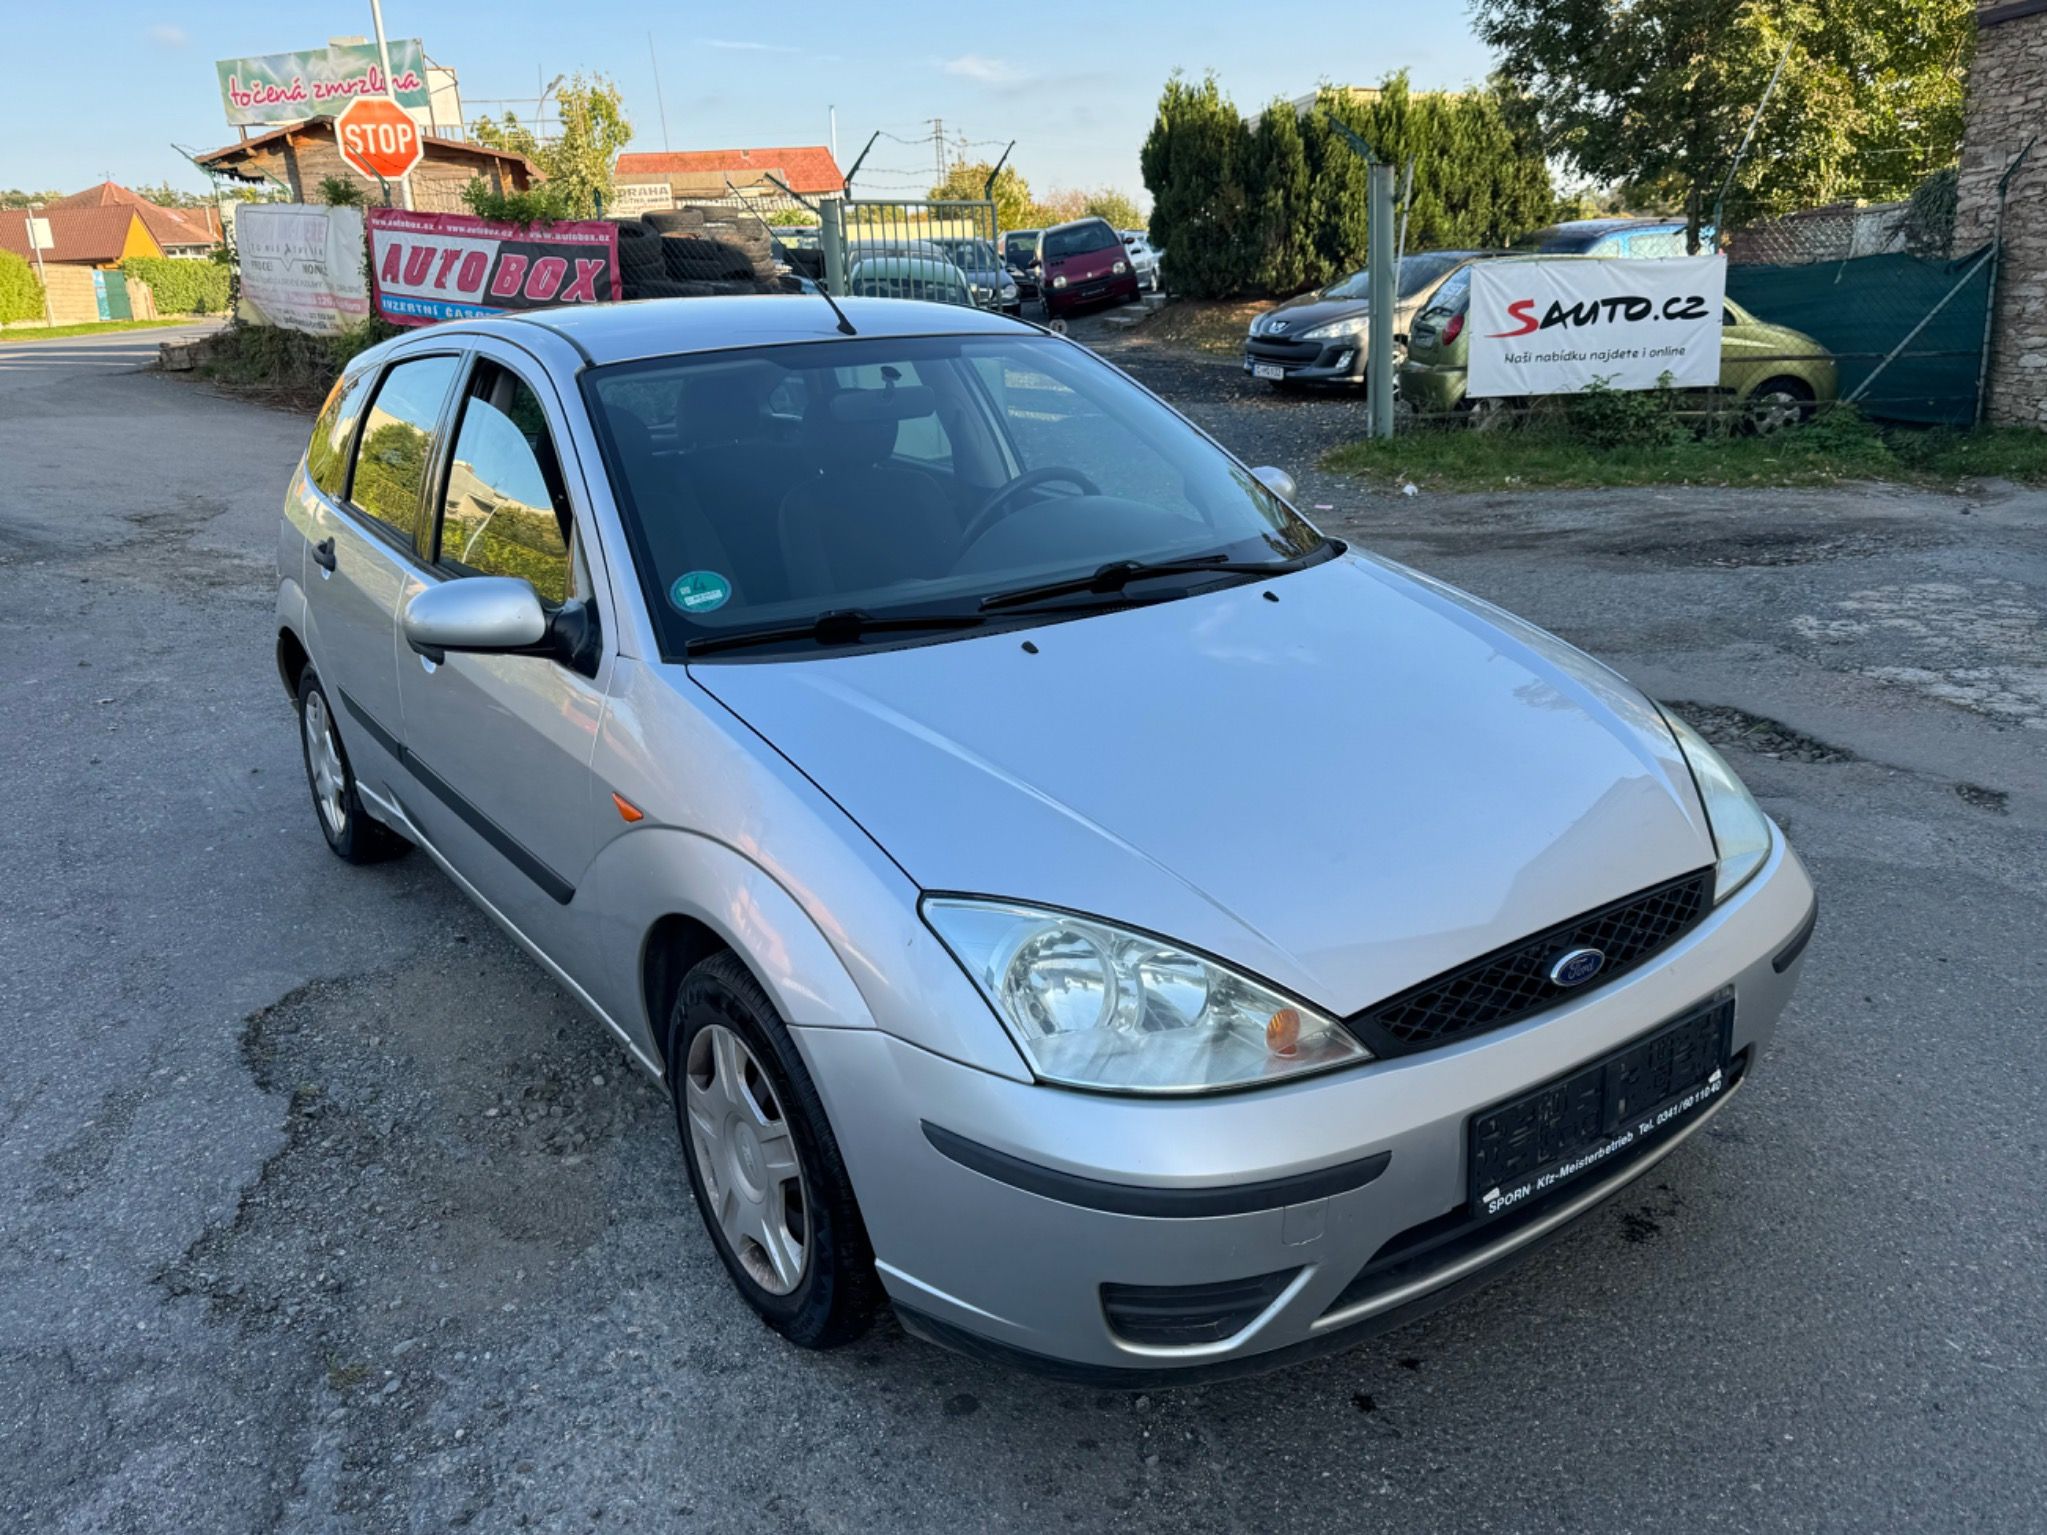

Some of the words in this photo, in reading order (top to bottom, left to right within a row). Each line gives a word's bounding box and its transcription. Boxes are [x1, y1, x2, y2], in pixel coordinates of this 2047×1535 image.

[229, 77, 307, 107] točená
[345, 123, 413, 154] STOP
[382, 299, 438, 316] INZERTNÍ
[1484, 296, 1710, 338] SAUTO.CZ
[1504, 352, 1532, 364] Naši
[1535, 349, 1587, 362] nabídku
[1590, 347, 1639, 363] najdete
[1641, 347, 1647, 358] i
[1649, 346, 1686, 358] online
[1566, 957, 1595, 980] Ford
[1488, 1183, 1531, 1214] SPORN
[1536, 1131, 1634, 1190] Kfz-Meisterbetrieb
[1639, 1118, 1655, 1135] Tel.
